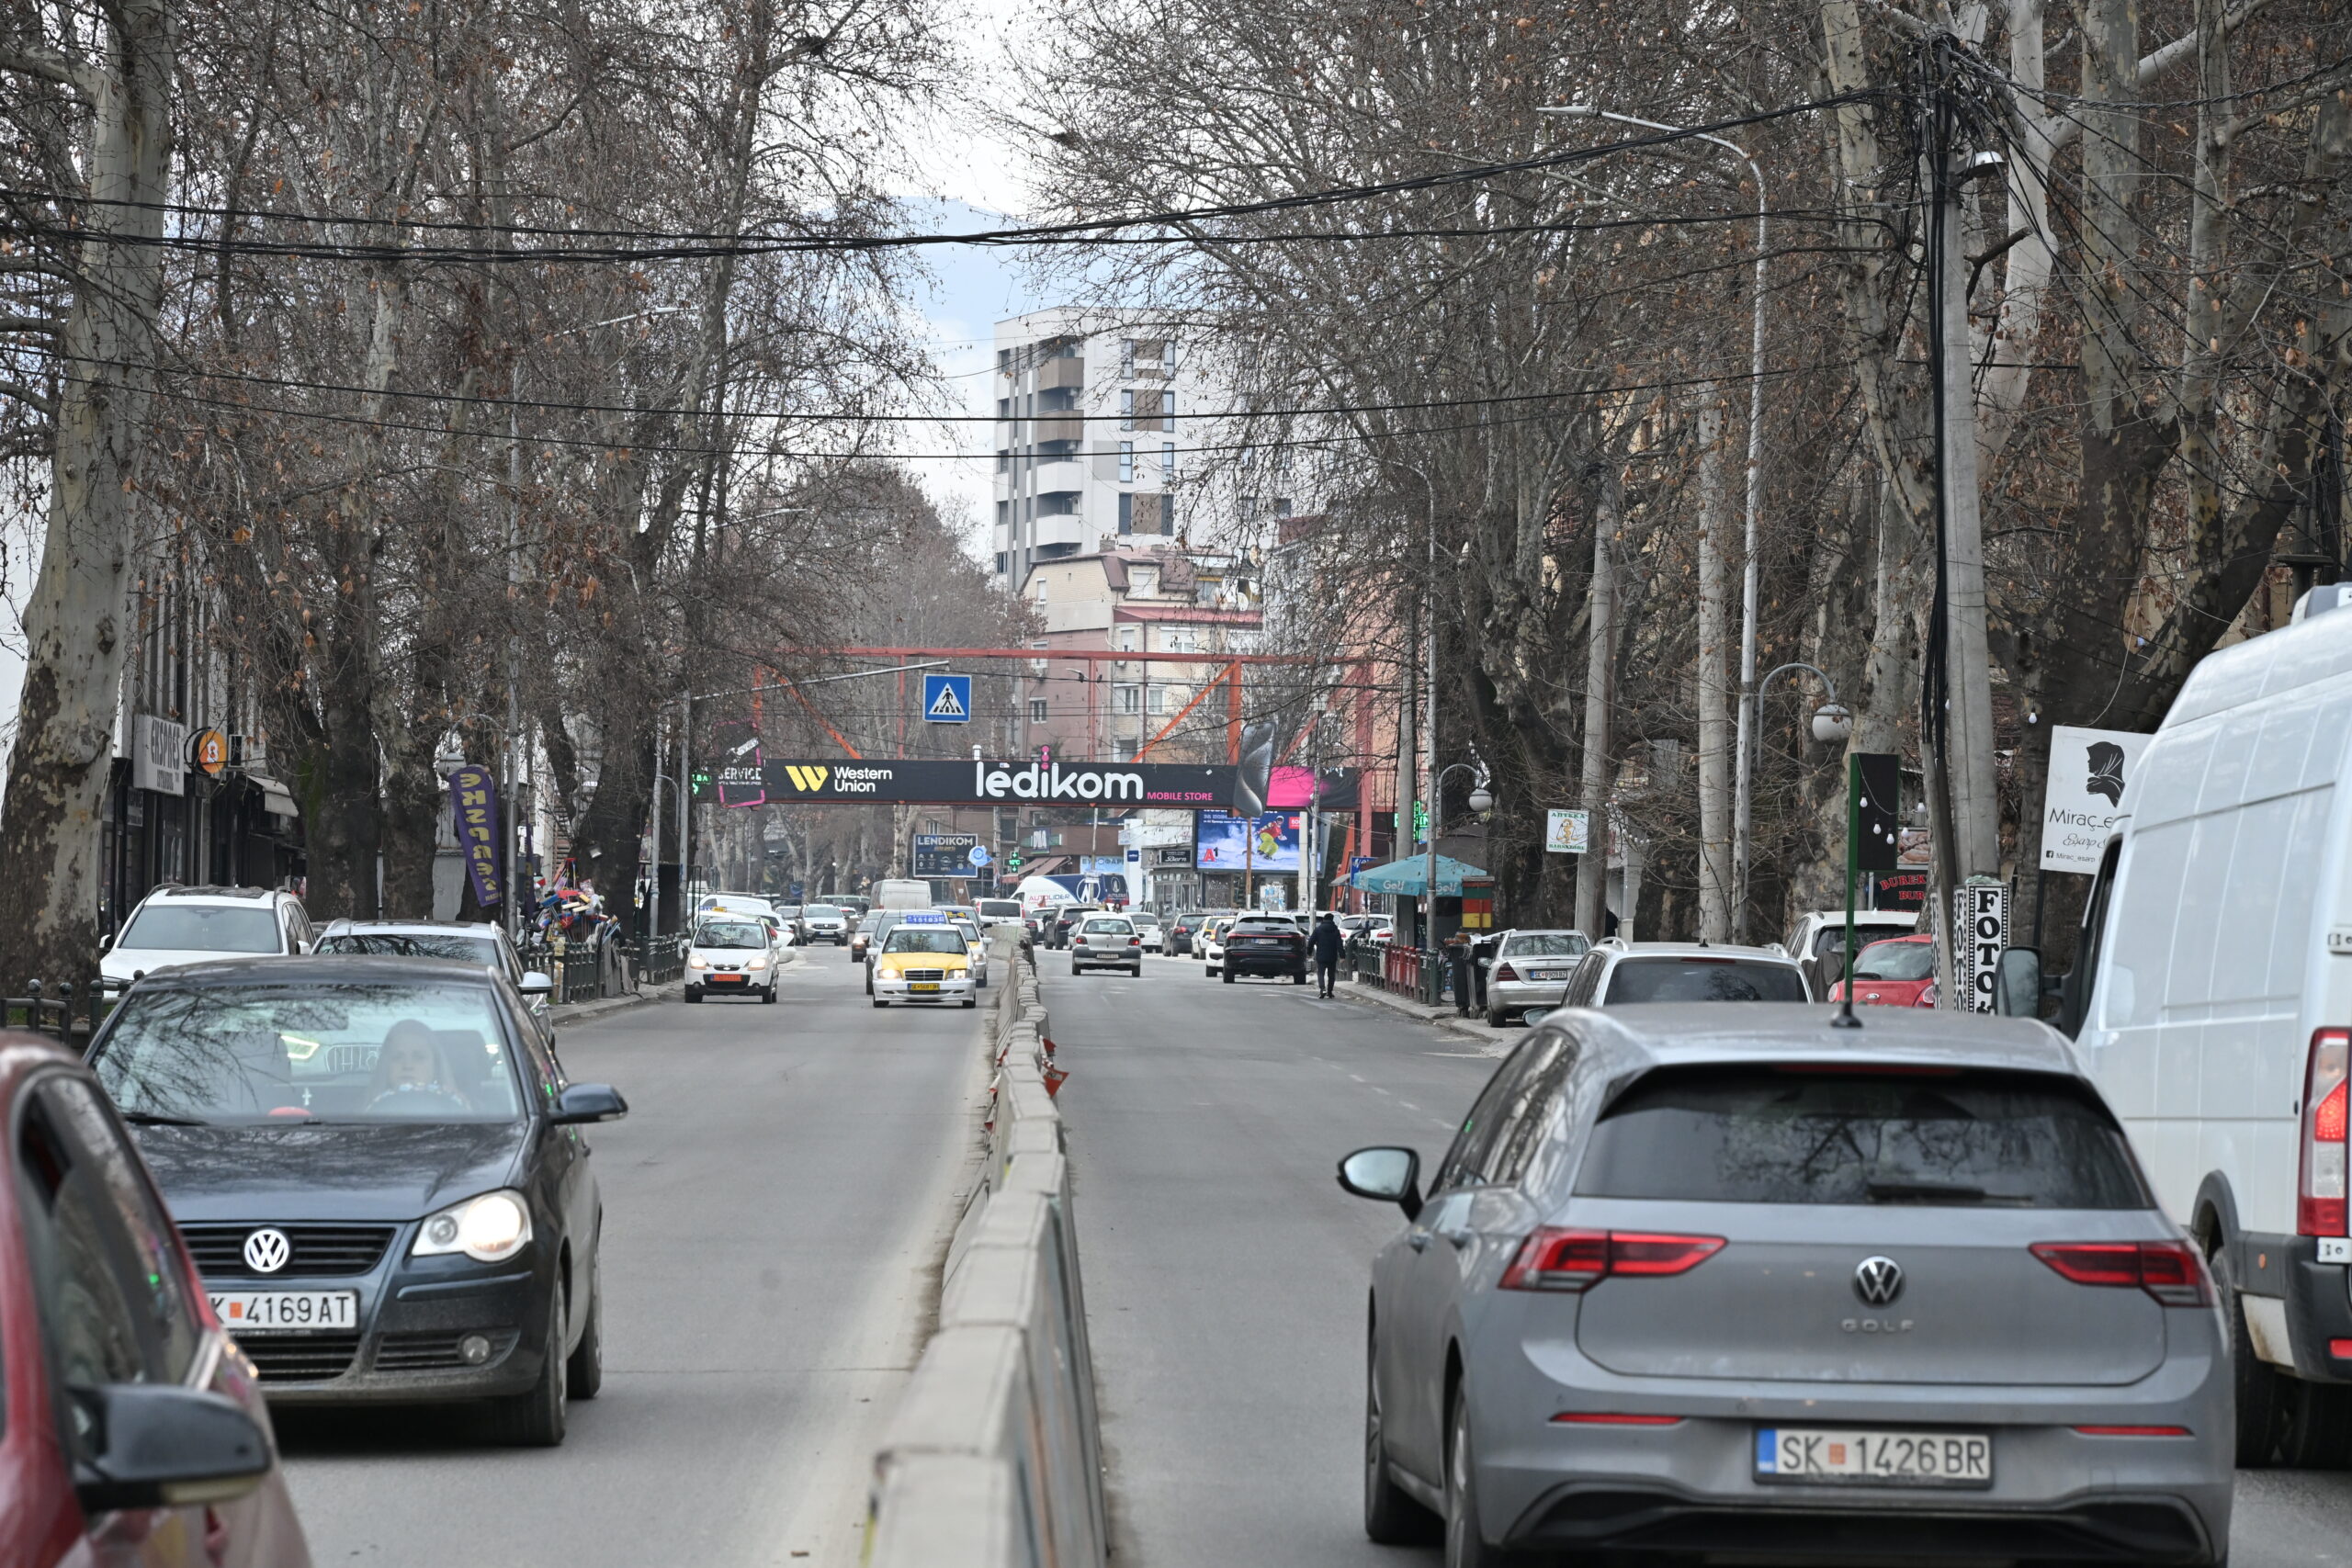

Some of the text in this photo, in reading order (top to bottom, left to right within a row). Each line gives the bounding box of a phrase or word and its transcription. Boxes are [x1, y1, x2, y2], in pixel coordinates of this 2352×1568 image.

[834, 766, 893, 780] Western
[976, 746, 1144, 801] ledikom
[833, 780, 876, 793] Union
[1147, 791, 1214, 801] MOBILE STORE
[2049, 807, 2112, 832] Miraç_e
[917, 837, 974, 845] LENDIKOM
[1899, 891, 1925, 900] BUR
[1975, 890, 2001, 994] FOTO
[1841, 1318, 1915, 1332] GOLF
[1782, 1435, 1824, 1472] SK
